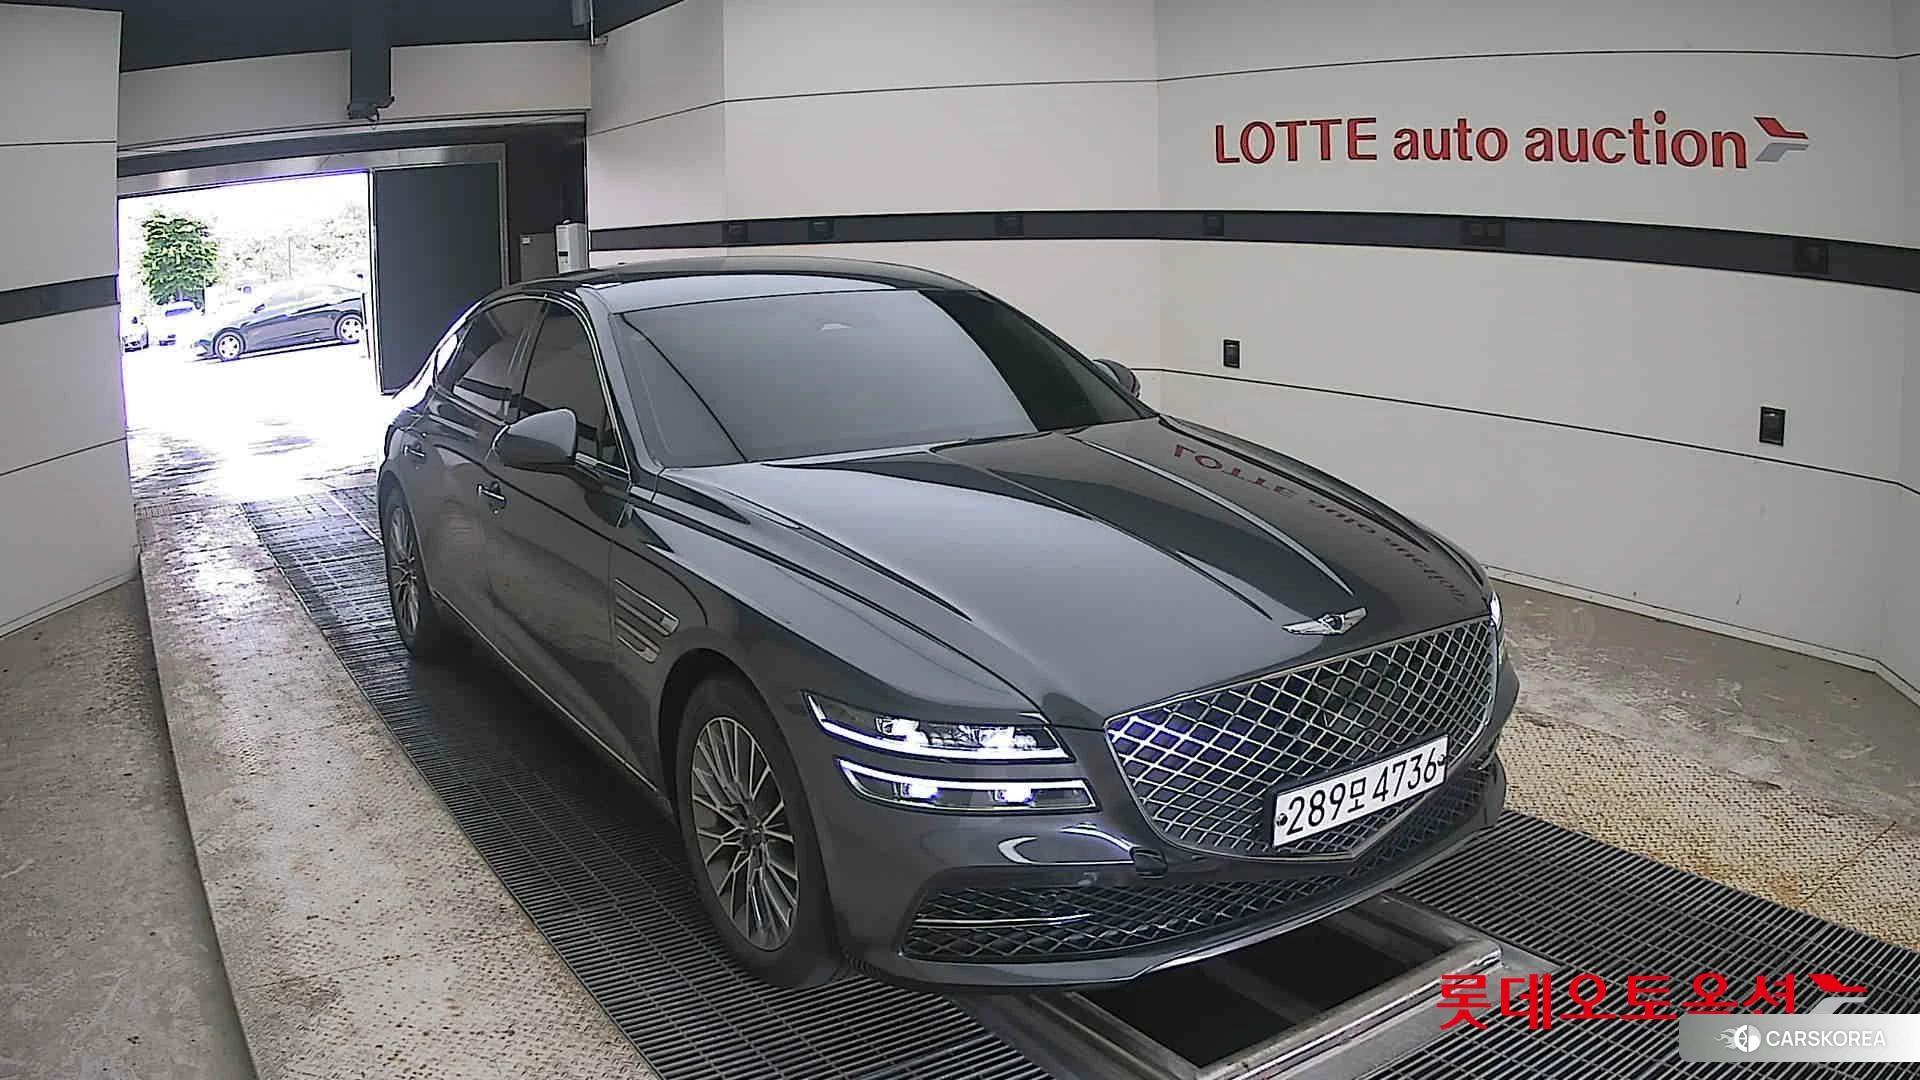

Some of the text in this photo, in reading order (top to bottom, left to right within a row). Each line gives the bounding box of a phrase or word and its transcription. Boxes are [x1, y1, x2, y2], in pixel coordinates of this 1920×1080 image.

[1215, 110, 1748, 168] LOTTE auto auction
[1286, 747, 1437, 836] 289모 4736
